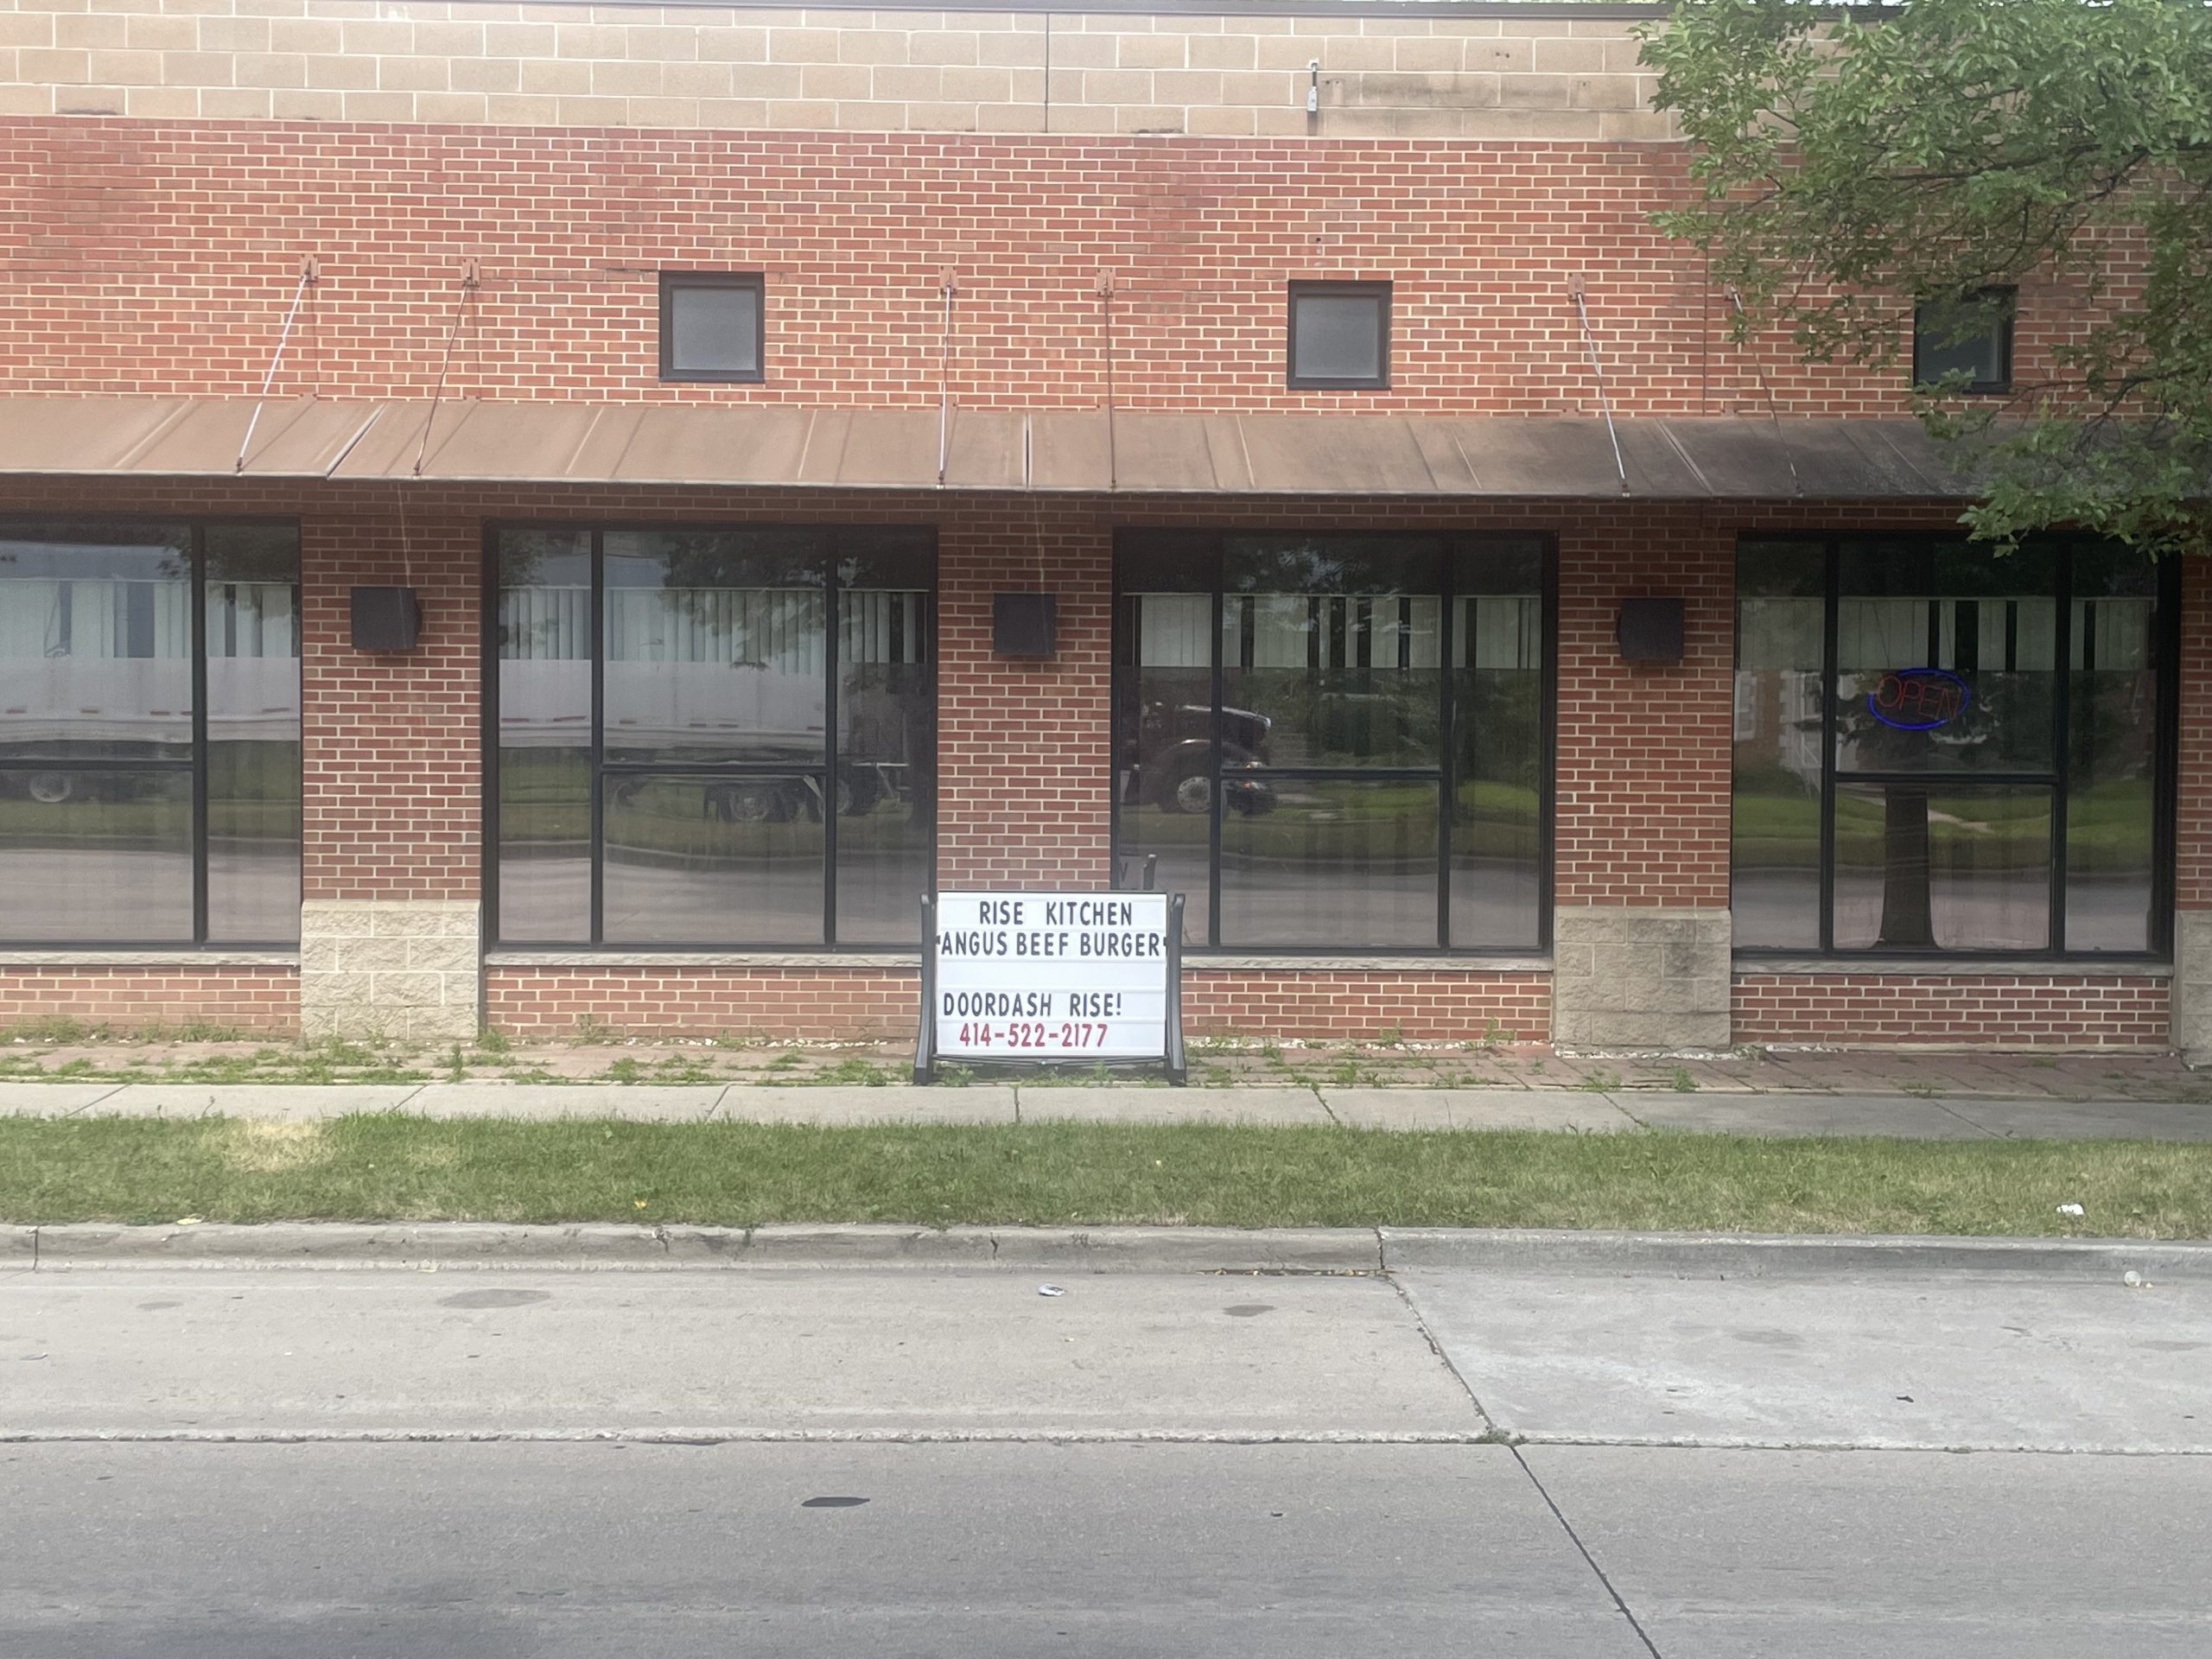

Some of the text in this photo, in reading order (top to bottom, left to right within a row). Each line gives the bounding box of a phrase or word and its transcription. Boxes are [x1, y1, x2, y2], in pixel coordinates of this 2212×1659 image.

[1878, 675, 1961, 719] OPEN
[980, 900, 1132, 926] RISE KITCHEN
[941, 931, 1160, 957] ANGUS BEEF BURGER
[944, 992, 1122, 1017] DOORDASH RISE!
[959, 1022, 1108, 1047] 414-522-2177
